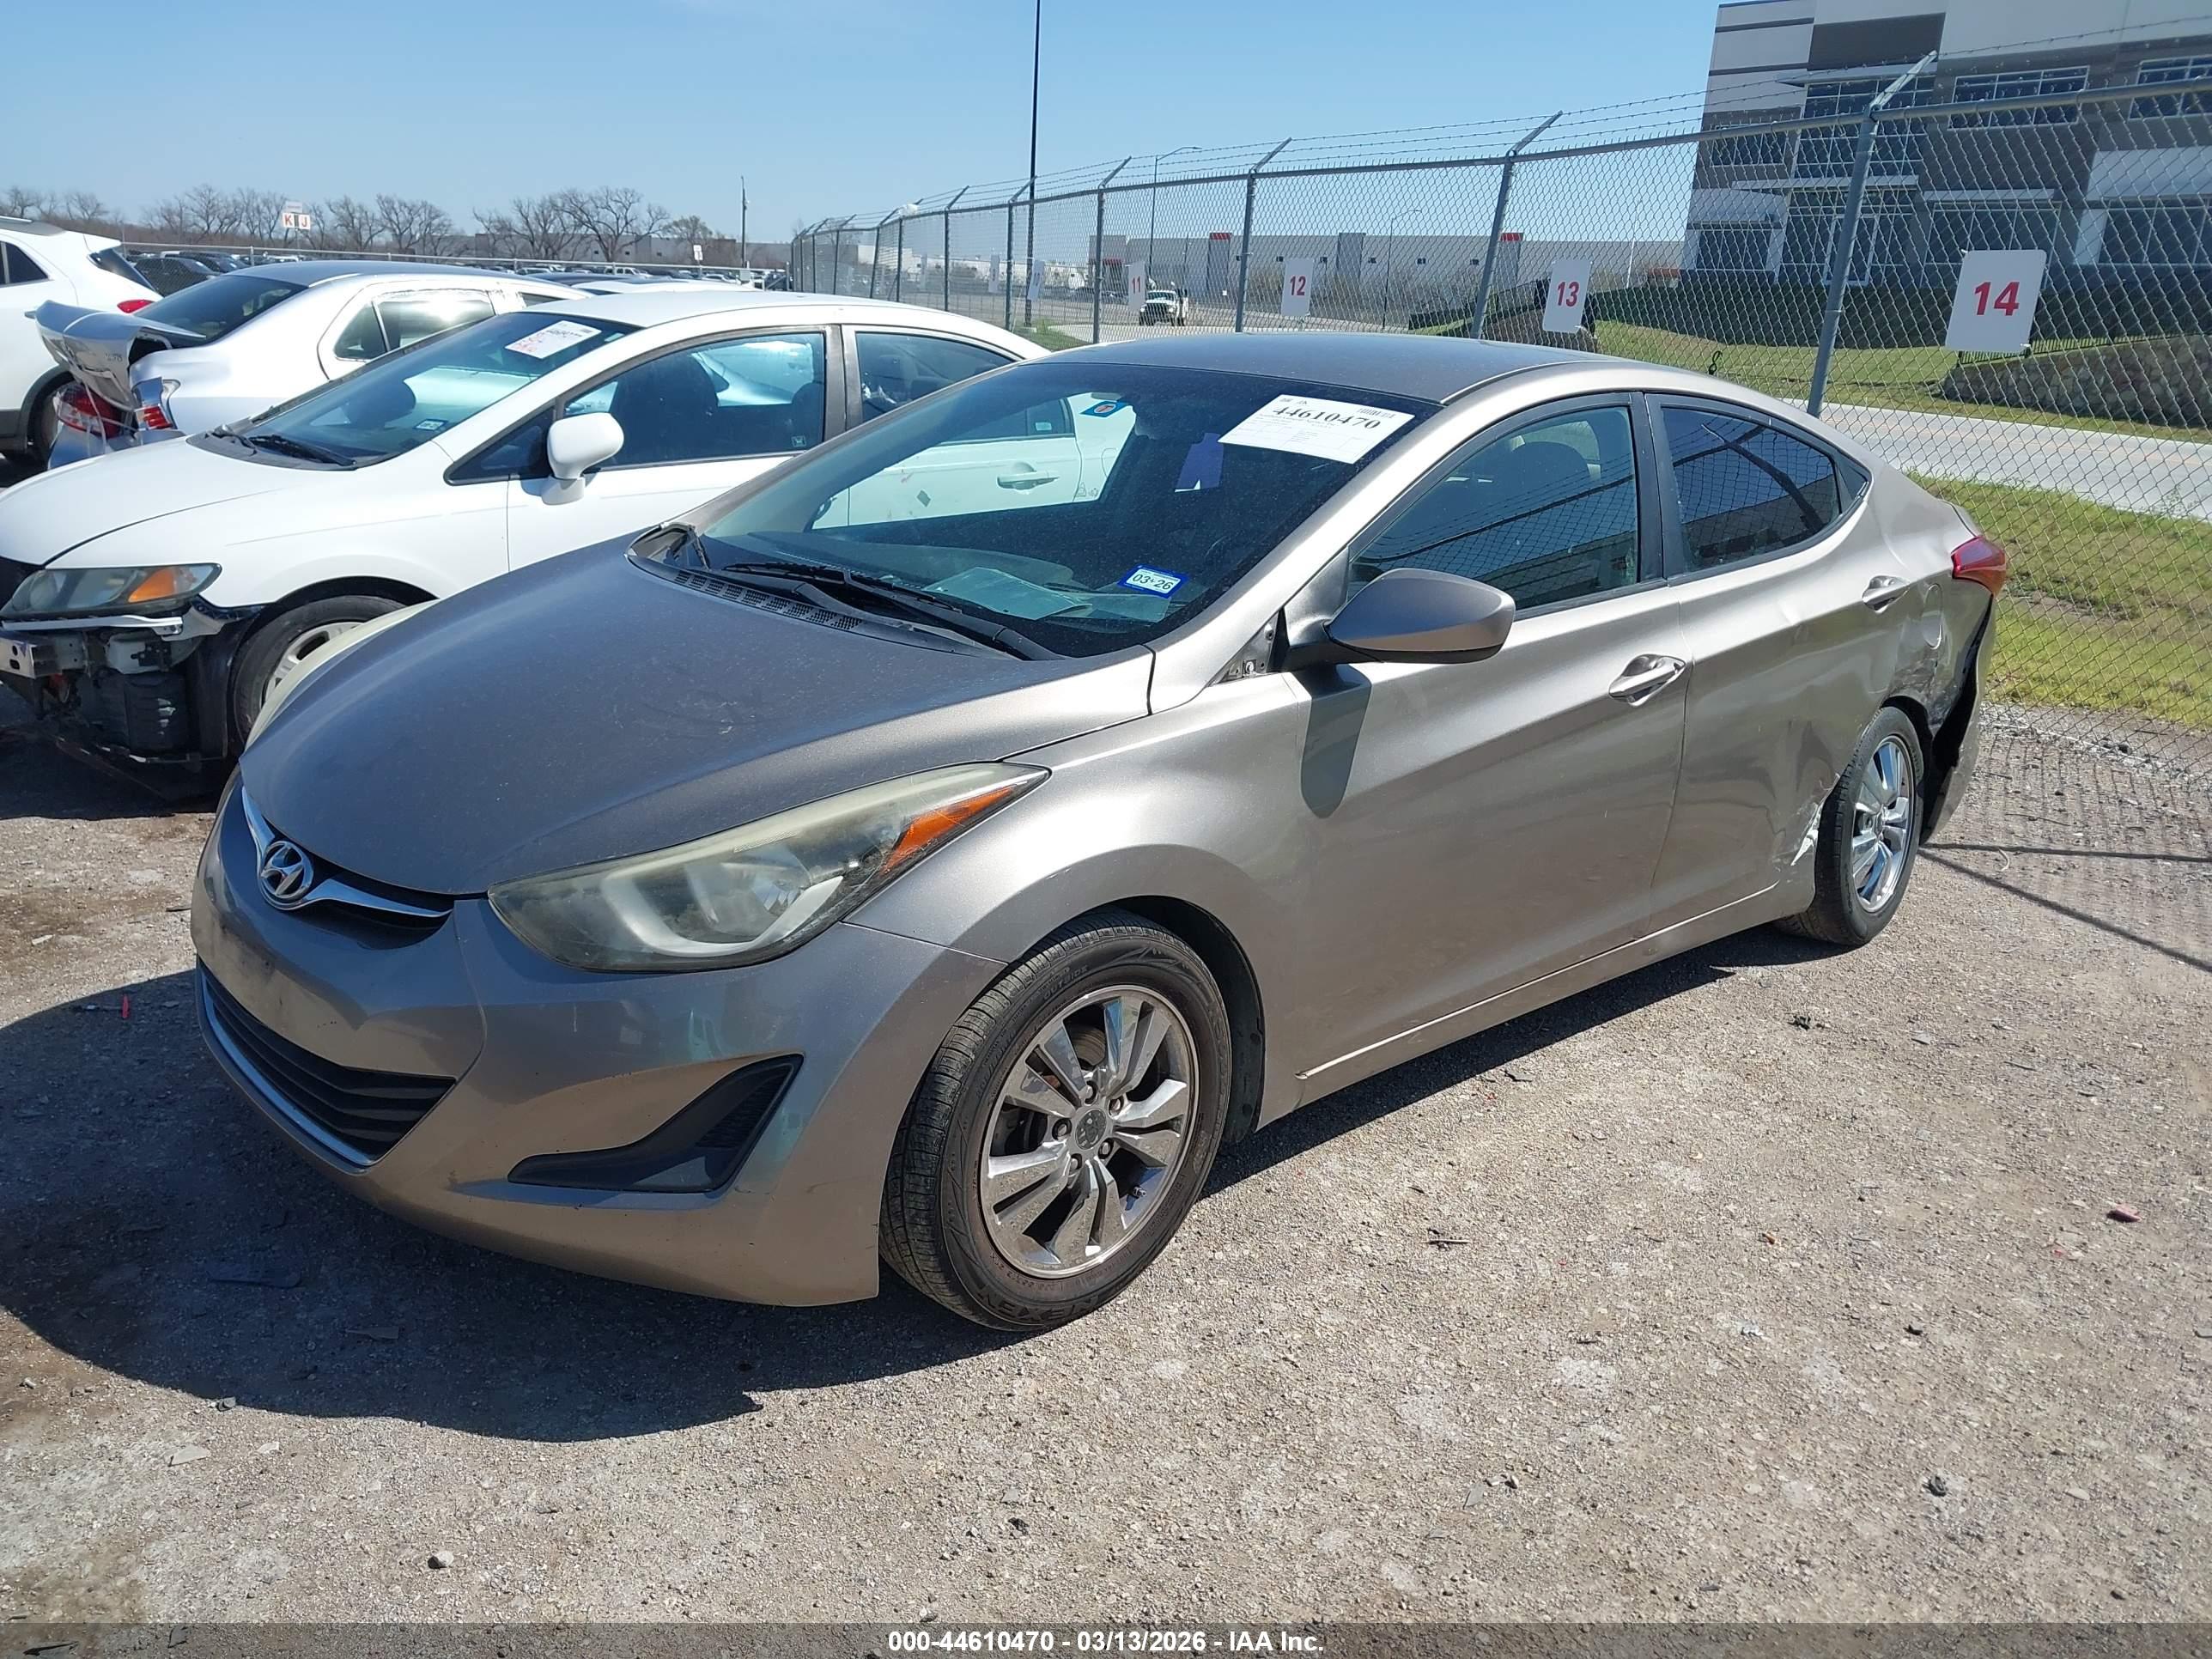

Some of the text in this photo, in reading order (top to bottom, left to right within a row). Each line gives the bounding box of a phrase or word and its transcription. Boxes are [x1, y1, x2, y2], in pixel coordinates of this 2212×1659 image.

[284, 214, 293, 226] K
[301, 216, 307, 228] J
[1132, 276, 1141, 294] 11
[1290, 275, 1306, 296] 12
[1557, 281, 1580, 307] 13
[1974, 281, 2021, 316] 14
[1273, 406, 1382, 429] 44610470
